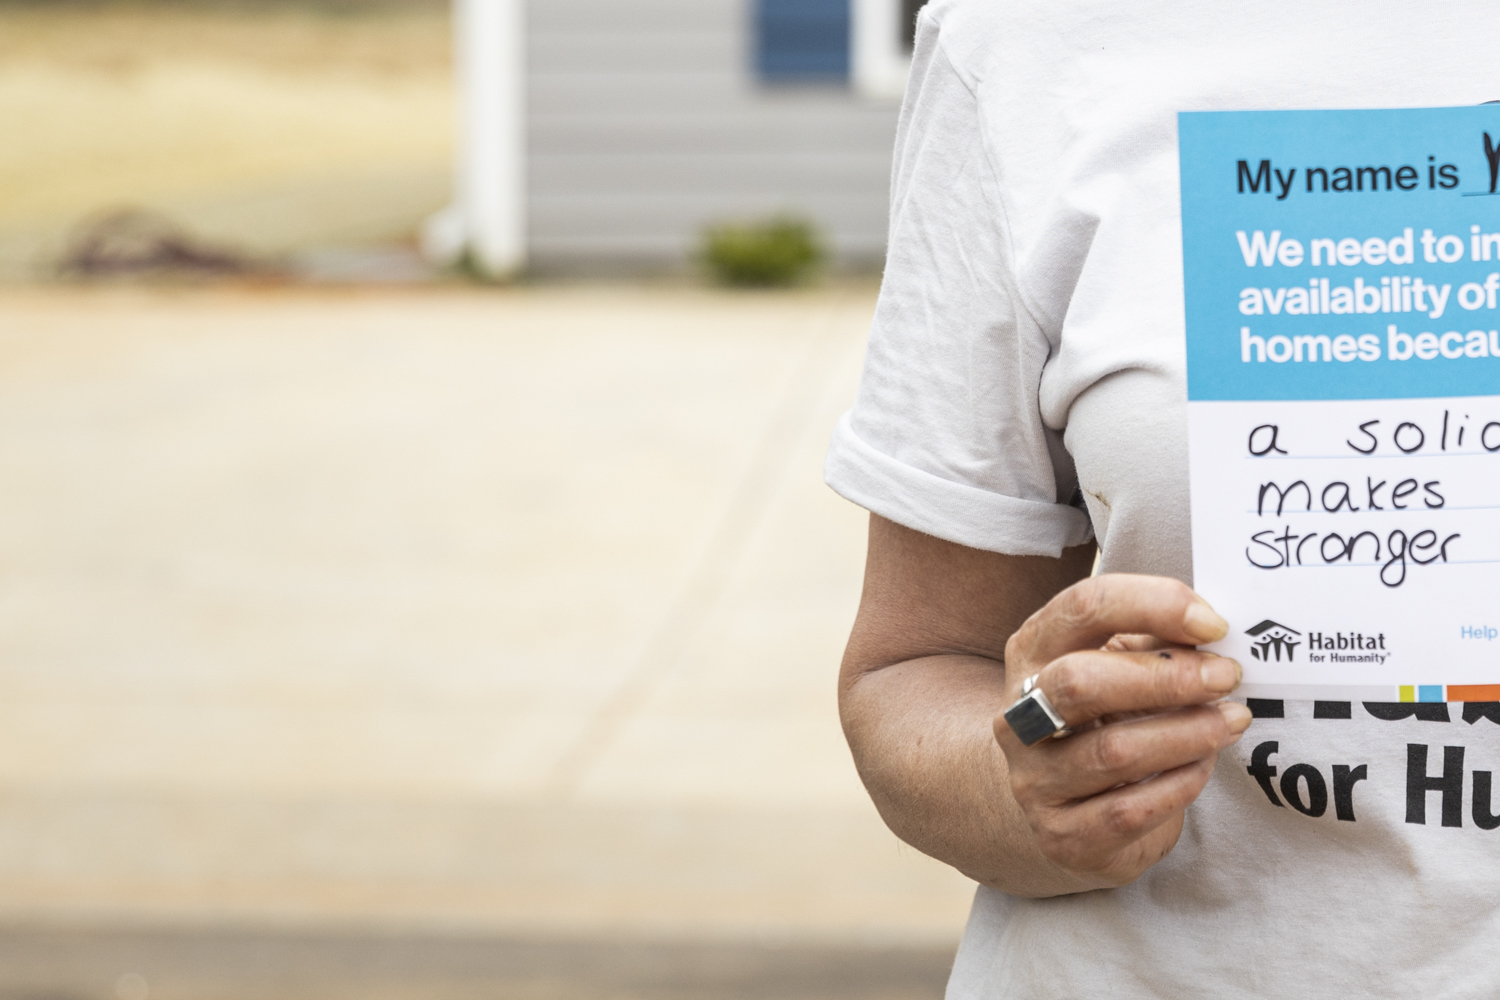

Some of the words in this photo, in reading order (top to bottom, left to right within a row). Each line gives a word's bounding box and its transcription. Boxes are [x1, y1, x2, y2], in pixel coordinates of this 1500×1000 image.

[1237, 159, 1294, 200] My
[1306, 161, 1419, 191] name
[1427, 155, 1459, 189] is
[1237, 231, 1304, 267] We
[1311, 228, 1413, 265] need
[1423, 228, 1464, 263] to
[1239, 276, 1450, 319] availability
[1458, 273, 1500, 310] of
[1240, 327, 1380, 363] homes
[1248, 422, 1287, 456] a
[1257, 475, 1445, 516] makes
[1246, 525, 1460, 587] stronger
[1309, 632, 1385, 650] Habitat
[1461, 625, 1498, 641] Help
[1310, 653, 1325, 662] for
[1247, 741, 1367, 823] for
